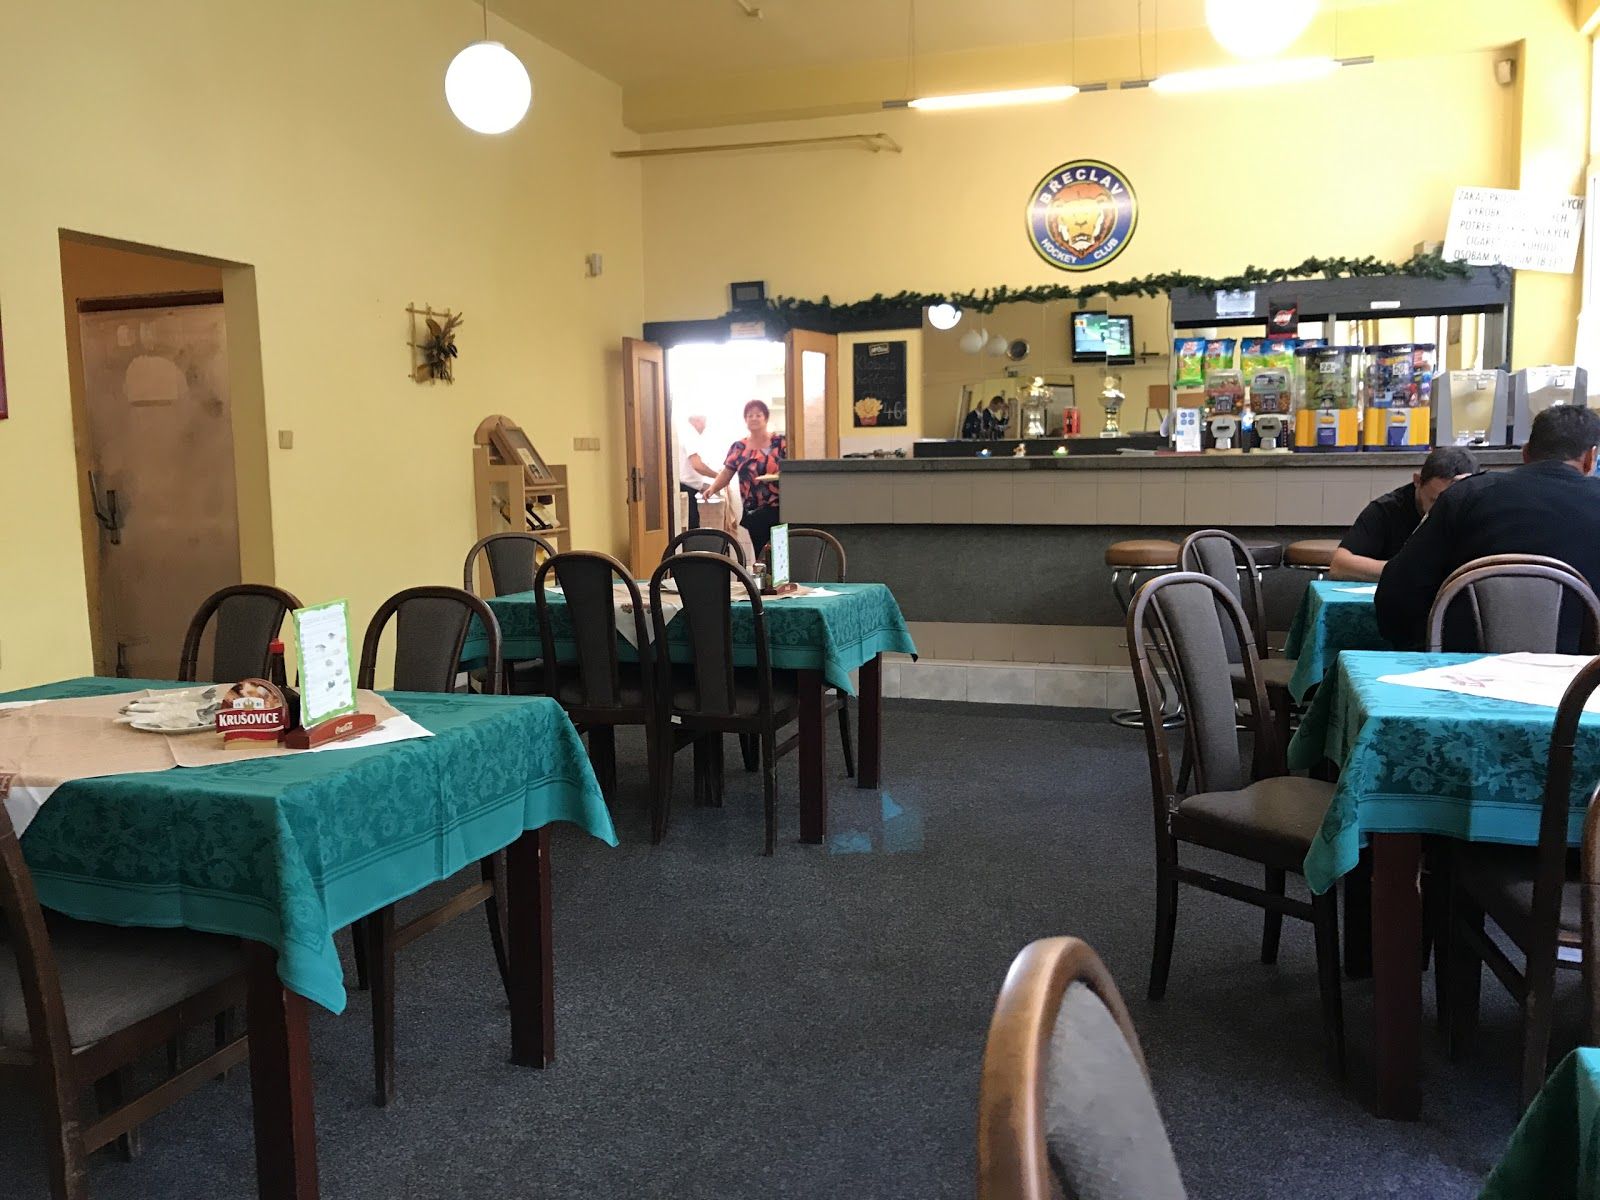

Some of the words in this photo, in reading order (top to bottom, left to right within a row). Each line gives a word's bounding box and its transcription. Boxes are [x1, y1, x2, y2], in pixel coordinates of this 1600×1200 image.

[1040, 169, 1124, 204] BRECLAV
[1041, 238, 1077, 264] HOCKEY
[1093, 238, 1119, 260] CLUB
[219, 712, 279, 726] KRUŠOVICE
